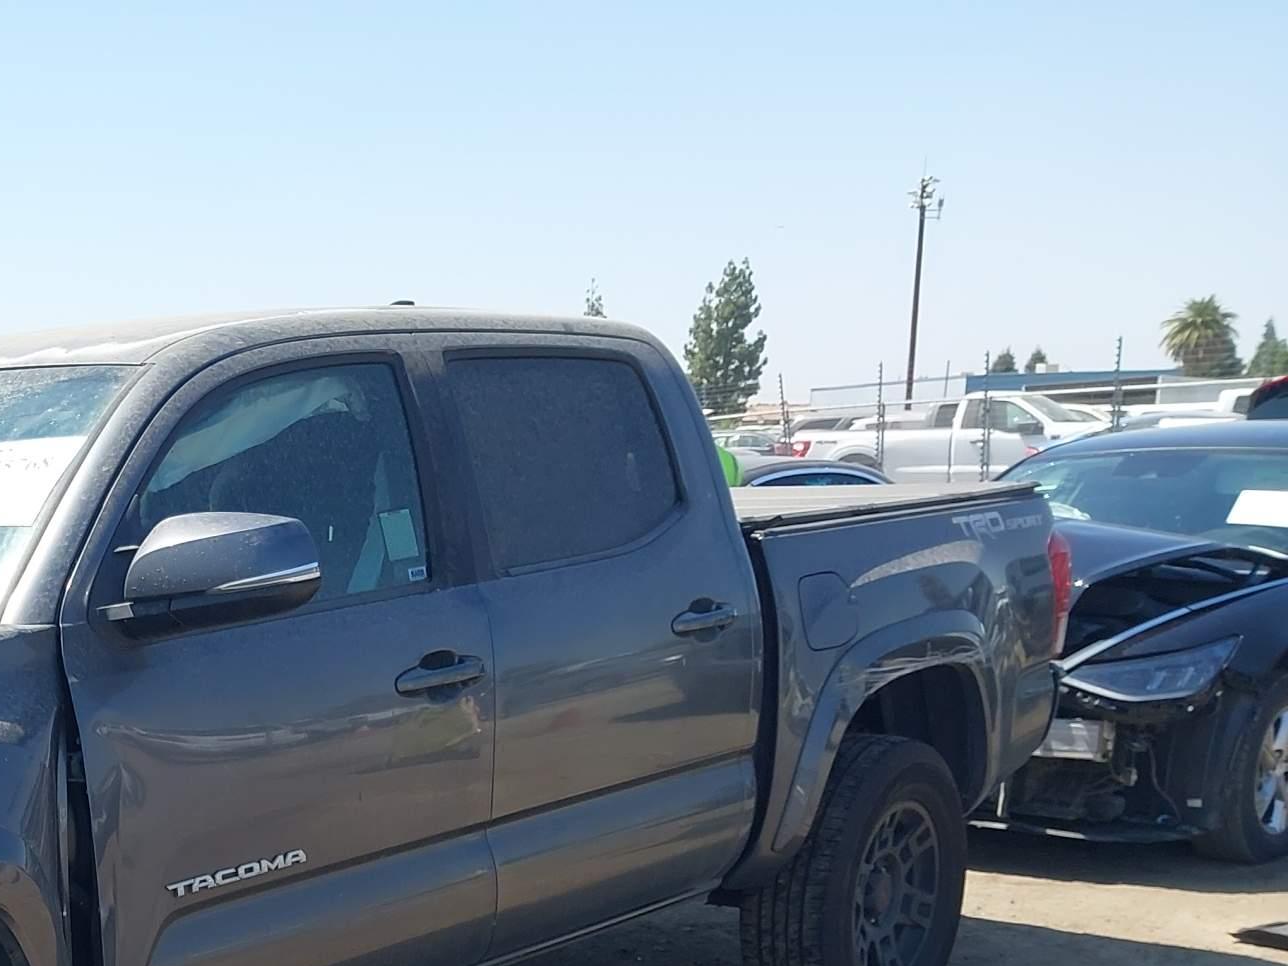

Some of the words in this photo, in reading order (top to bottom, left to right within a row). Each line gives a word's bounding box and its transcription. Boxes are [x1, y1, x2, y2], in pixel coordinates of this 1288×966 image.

[952, 511, 1005, 541] TRD
[1005, 514, 1043, 530] SPORT
[166, 849, 308, 897] TACOMA
